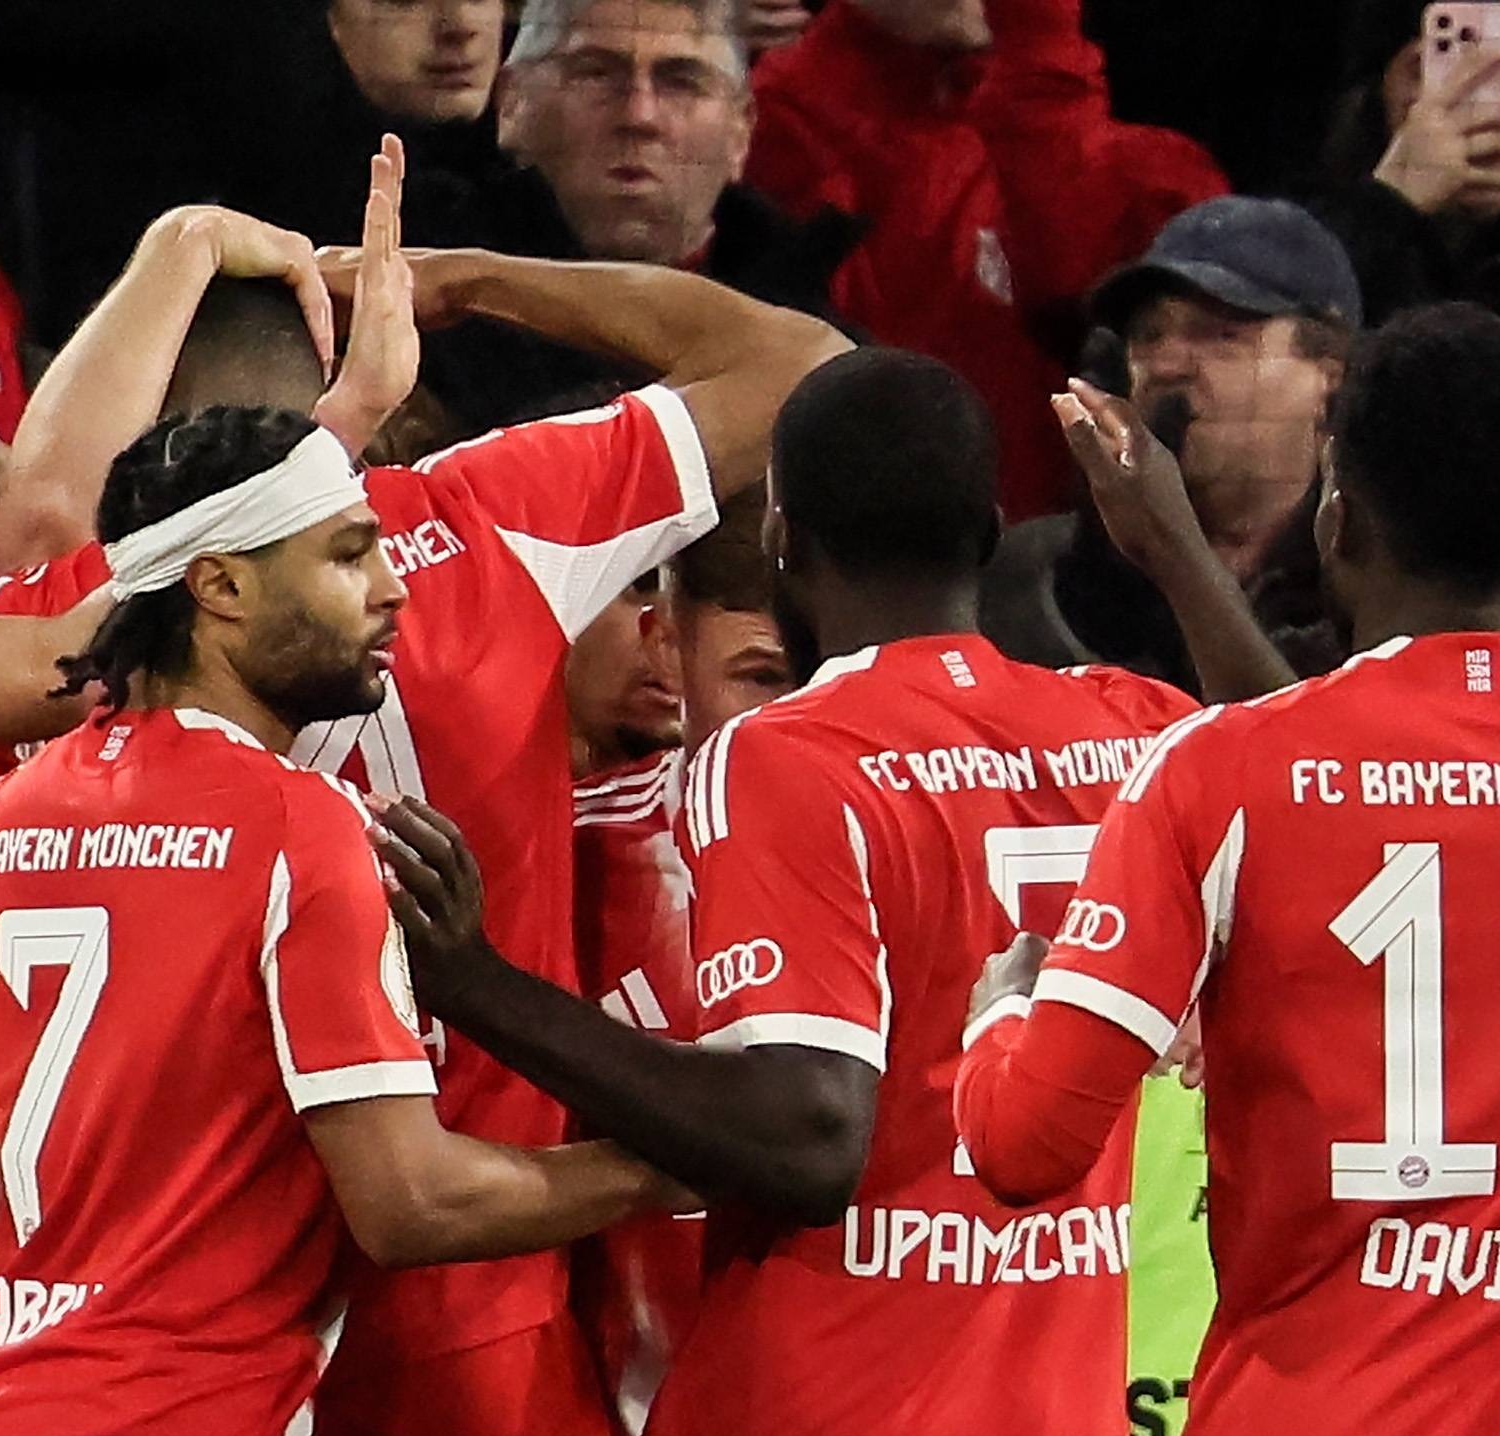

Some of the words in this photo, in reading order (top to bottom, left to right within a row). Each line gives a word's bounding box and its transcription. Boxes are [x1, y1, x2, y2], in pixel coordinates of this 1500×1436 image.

[858, 751, 911, 791] FC
[905, 745, 1038, 794] BAYERN
[1291, 759, 1344, 804] FC
[77, 822, 235, 870] MÜNCHEN
